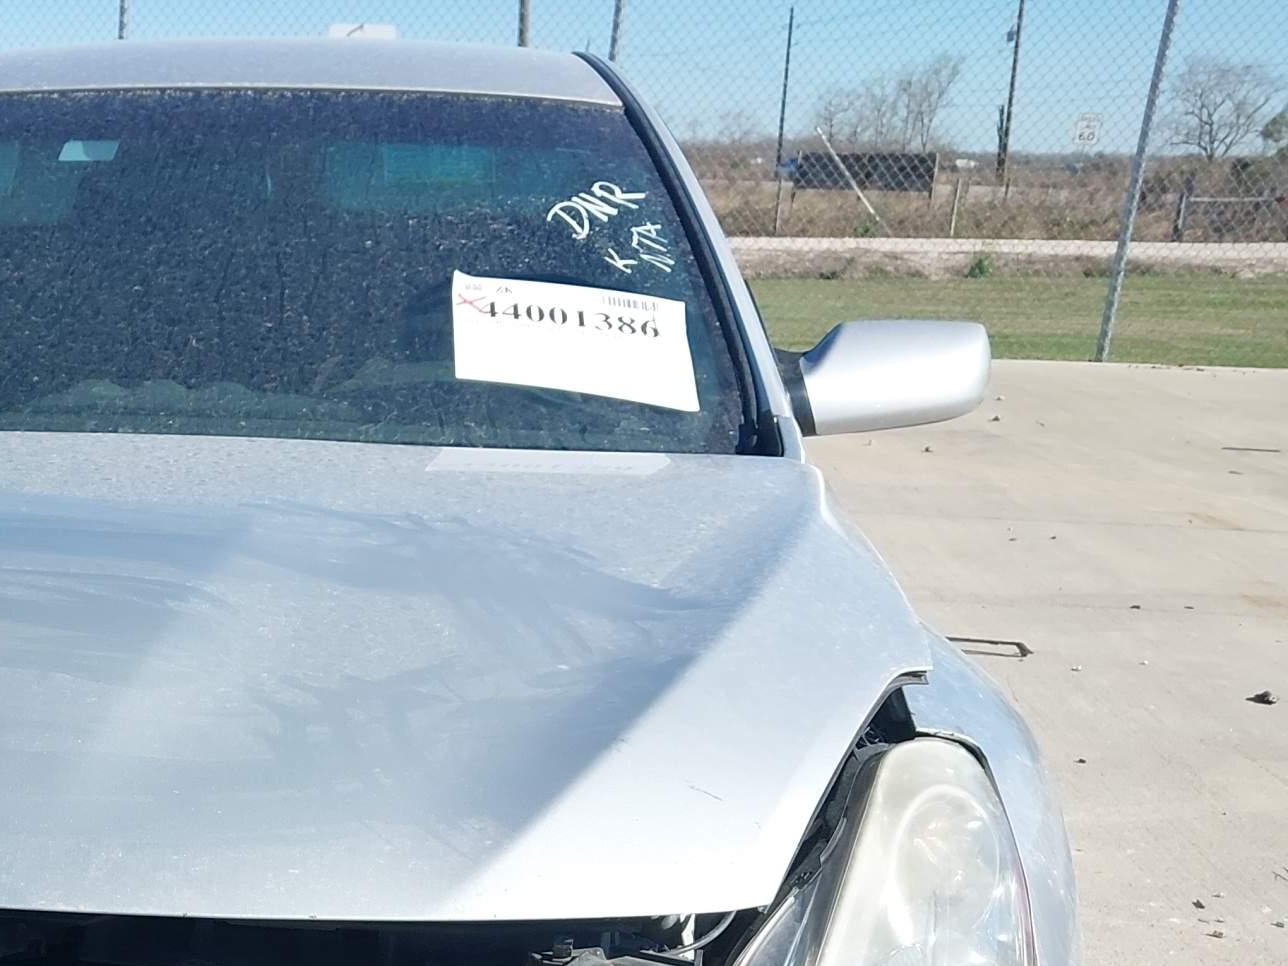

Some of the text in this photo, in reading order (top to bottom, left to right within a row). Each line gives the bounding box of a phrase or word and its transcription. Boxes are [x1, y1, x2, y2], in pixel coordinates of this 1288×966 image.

[546, 180, 647, 240] DNR
[603, 247, 639, 274] K
[479, 301, 661, 338] 44001386
